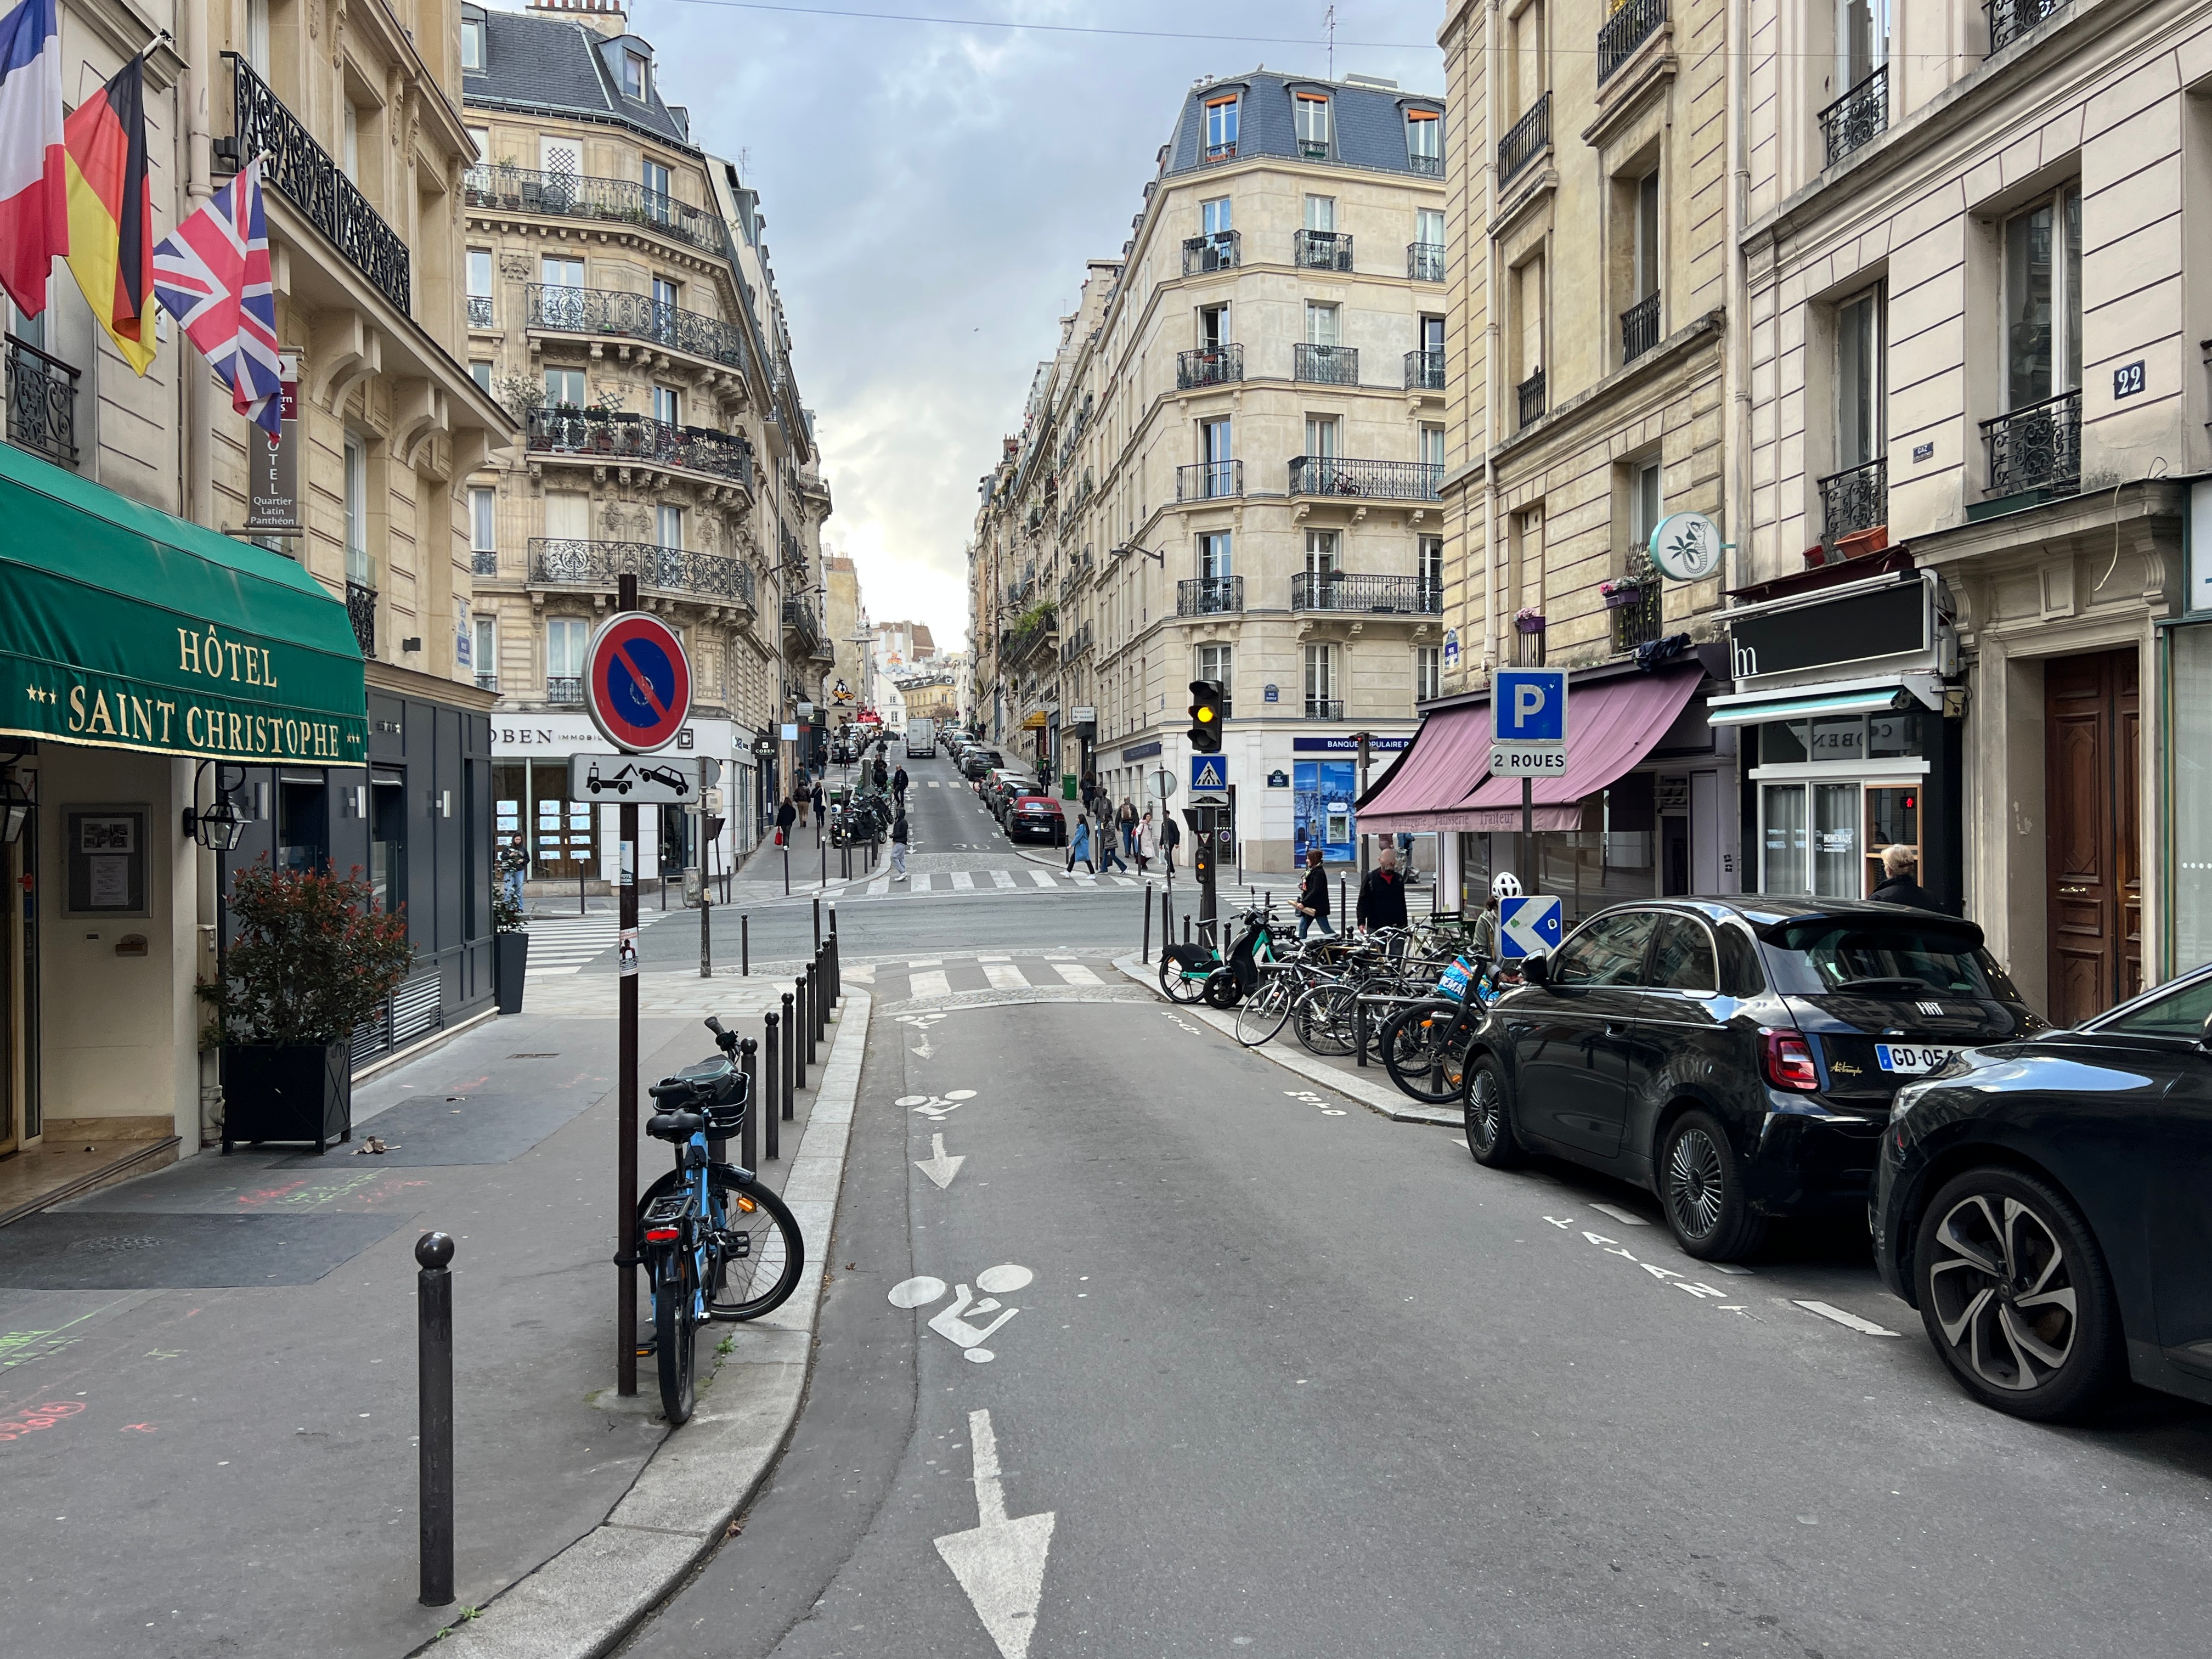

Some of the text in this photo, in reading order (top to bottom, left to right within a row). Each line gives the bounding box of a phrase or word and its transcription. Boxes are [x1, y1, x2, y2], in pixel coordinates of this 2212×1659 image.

[2118, 365, 2141, 395] 22
[1917, 445, 1928, 454] GAZ
[267, 440, 280, 494] OTEL
[253, 496, 292, 506] Quartier
[261, 507, 285, 515] Latin
[250, 516, 294, 525] Panthéon
[177, 624, 278, 689] HÔTEL
[1514, 684, 1545, 728] P
[69, 685, 341, 758] SAINT CHRISTOPHE
[491, 729, 552, 744] BEN
[1494, 754, 1564, 768] 2 ROUES
[1435, 813, 1470, 826] Pâtisserie
[1480, 812, 1515, 827] Traiteur
[1824, 833, 1853, 844] HOMEMADE
[1915, 1001, 1945, 1015] FIAT
[1283, 1091, 1347, 1116] MOTO
